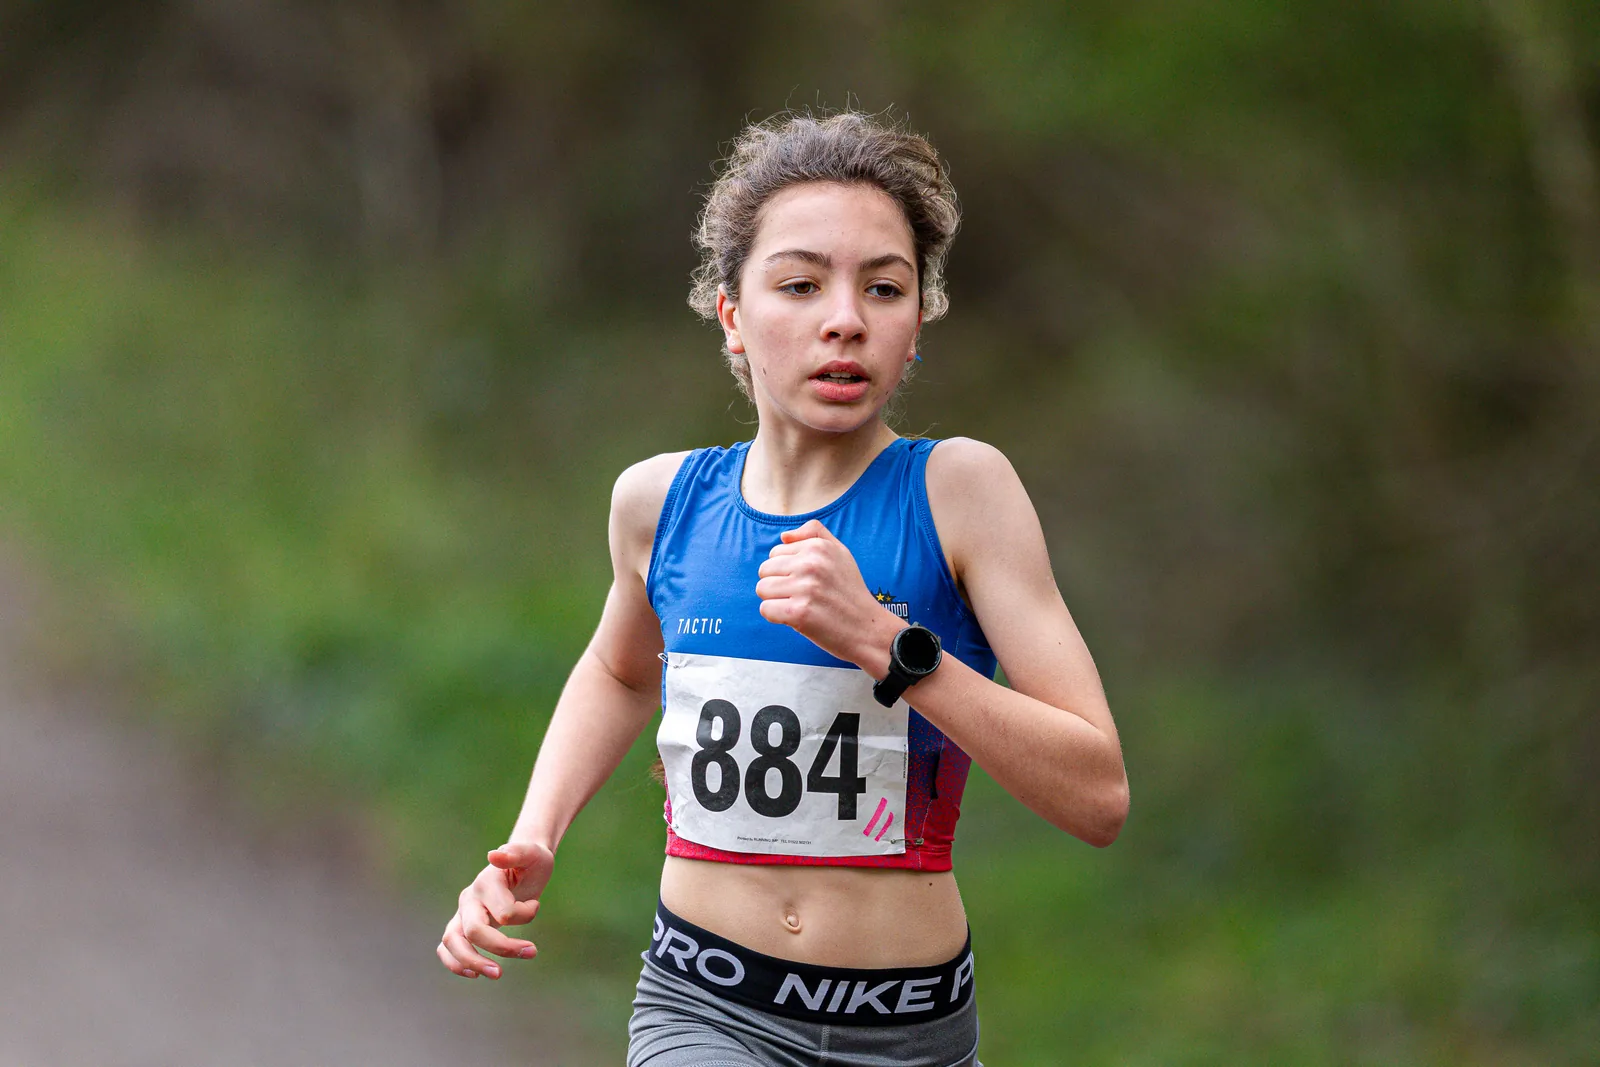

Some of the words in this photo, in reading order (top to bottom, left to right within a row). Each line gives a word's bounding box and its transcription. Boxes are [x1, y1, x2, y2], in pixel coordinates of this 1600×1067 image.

[677, 618, 722, 635] TACTIC
[691, 698, 867, 821] 884
[773, 973, 942, 1015] NIKE
